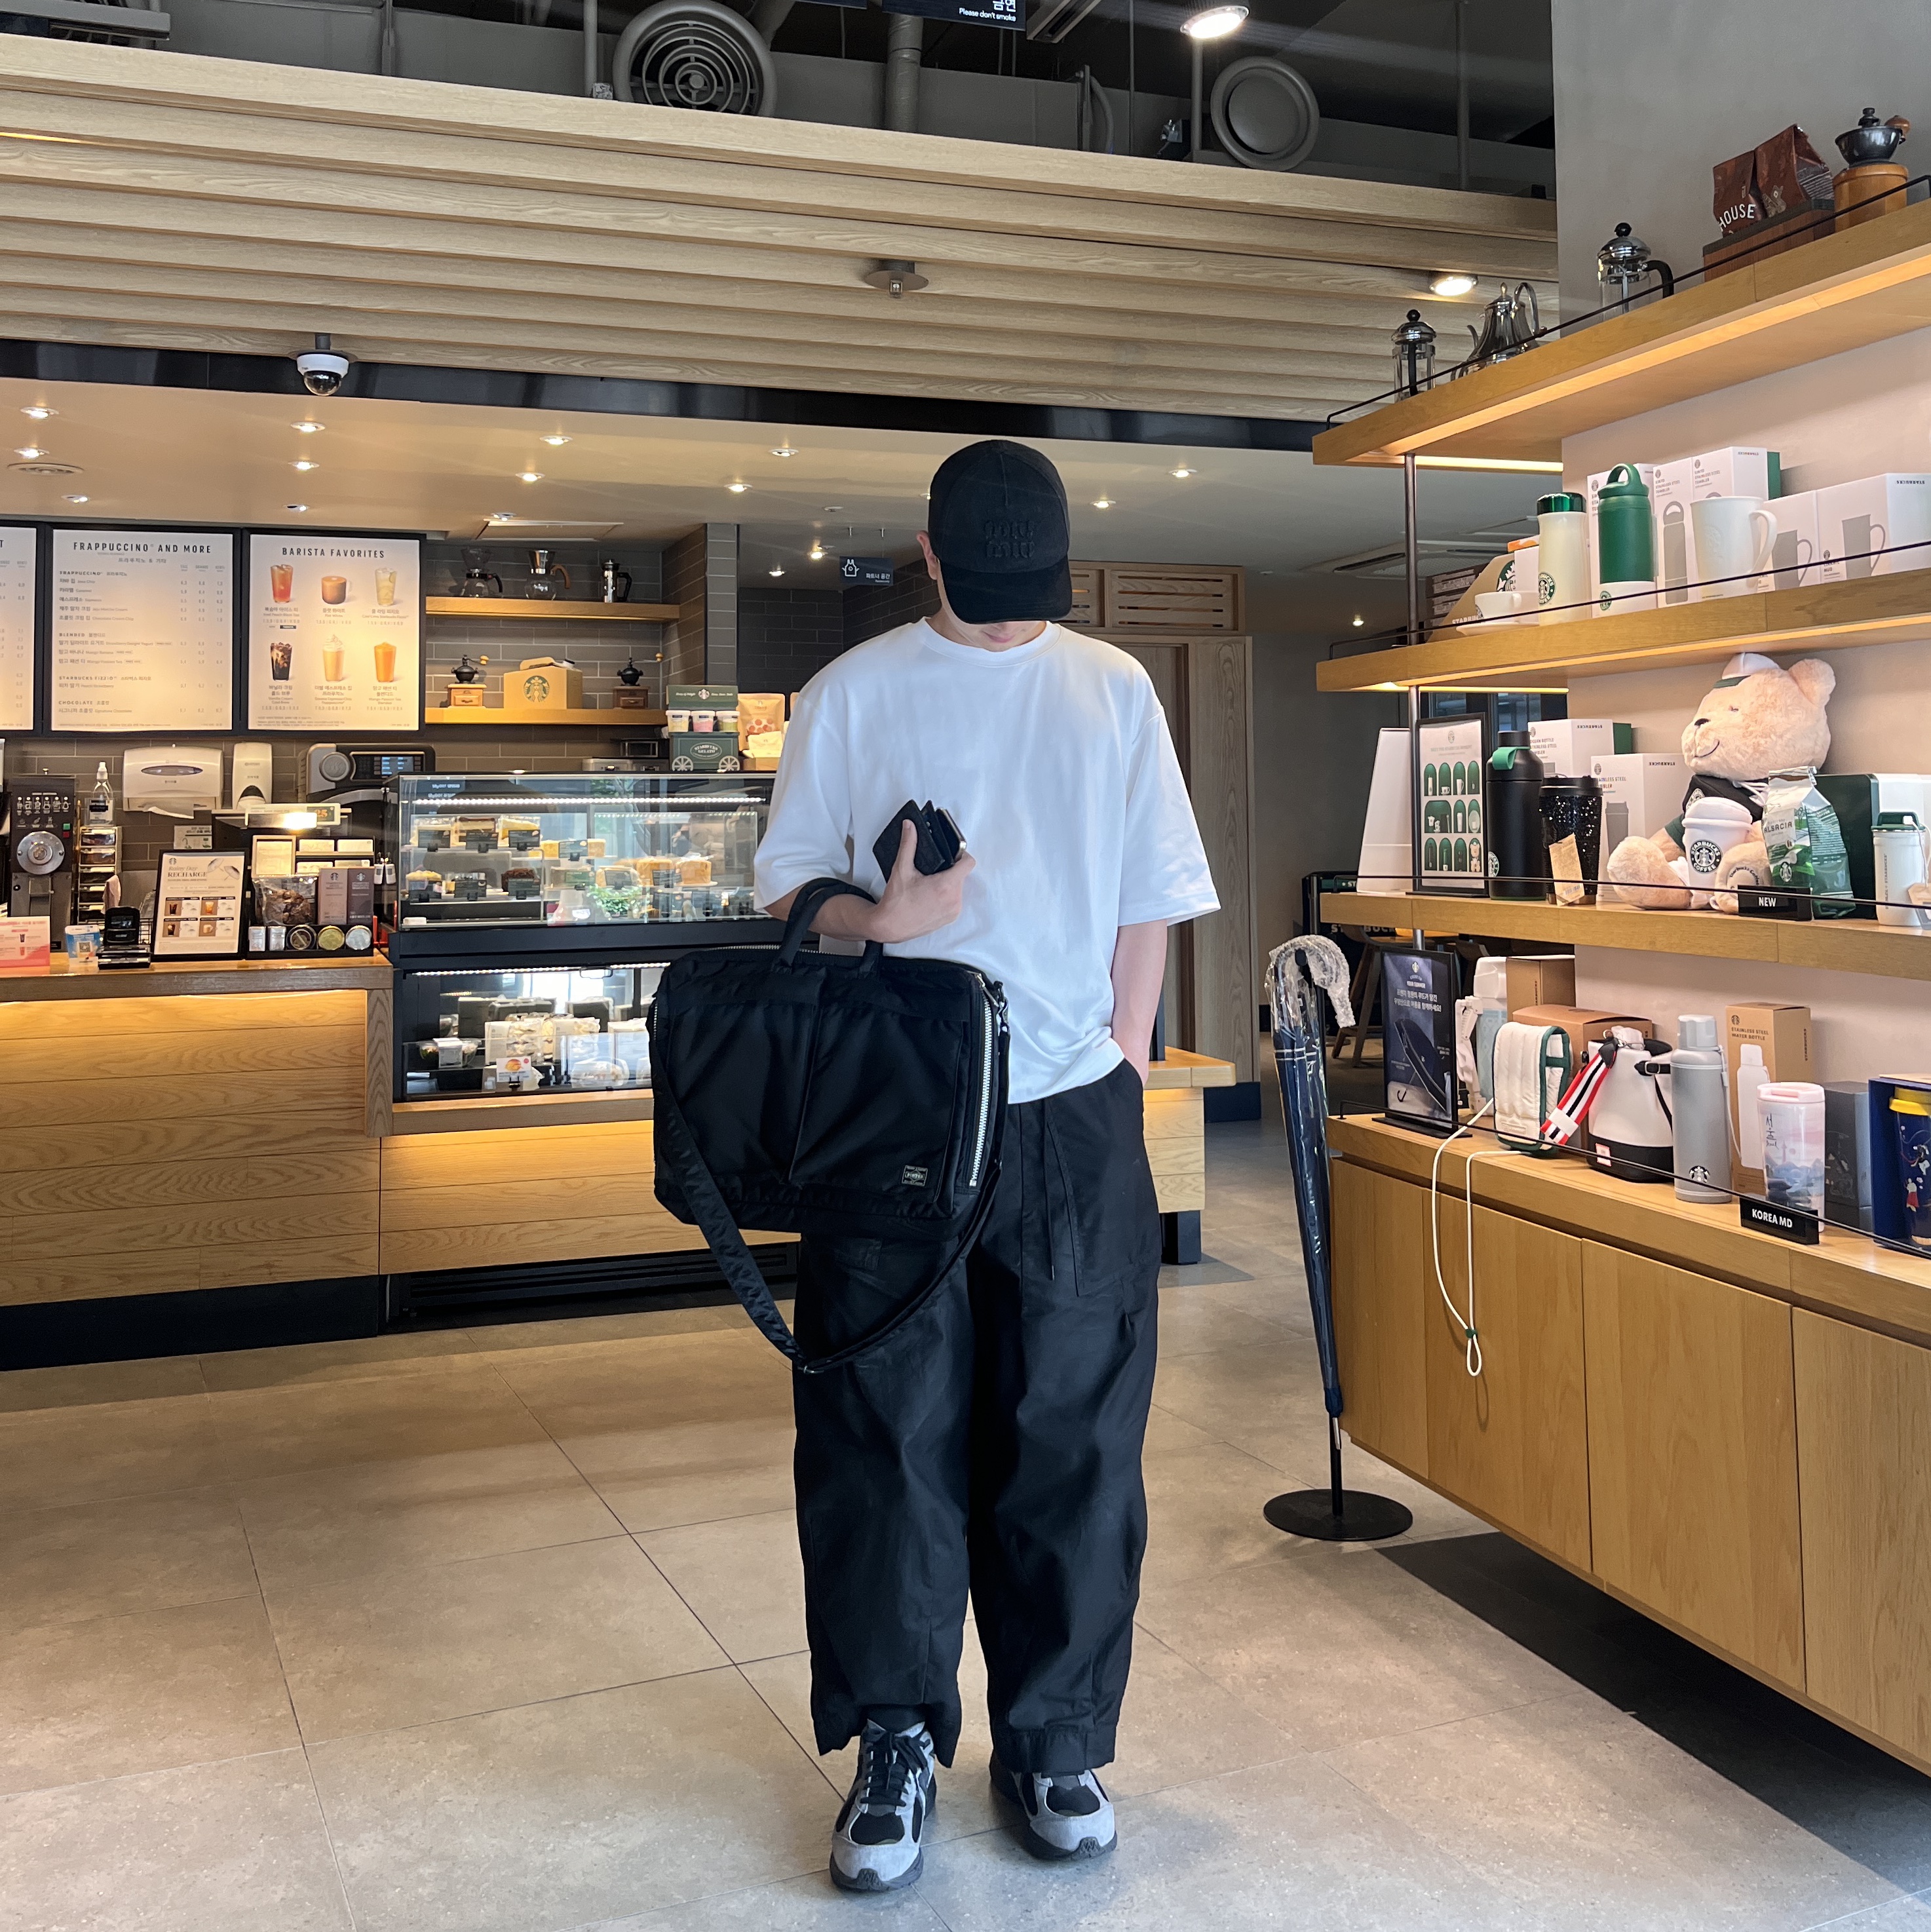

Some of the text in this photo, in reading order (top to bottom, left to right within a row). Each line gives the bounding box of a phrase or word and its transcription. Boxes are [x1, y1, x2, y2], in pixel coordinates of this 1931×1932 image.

[959, 8, 978, 17] Please
[980, 10, 995, 19] don't
[1717, 203, 1756, 231] HOUSE
[73, 542, 148, 552] FRAPPUCCINO
[331, 549, 385, 558] FAVORITES
[1452, 615, 1479, 624] STARBU
[1764, 821, 1793, 834] ALSACIA
[1691, 841, 1721, 856] STARBUCKS
[1693, 862, 1717, 872] COFFEE
[1759, 897, 1776, 907] NEW
[1751, 1208, 1793, 1228] KOREA MD
